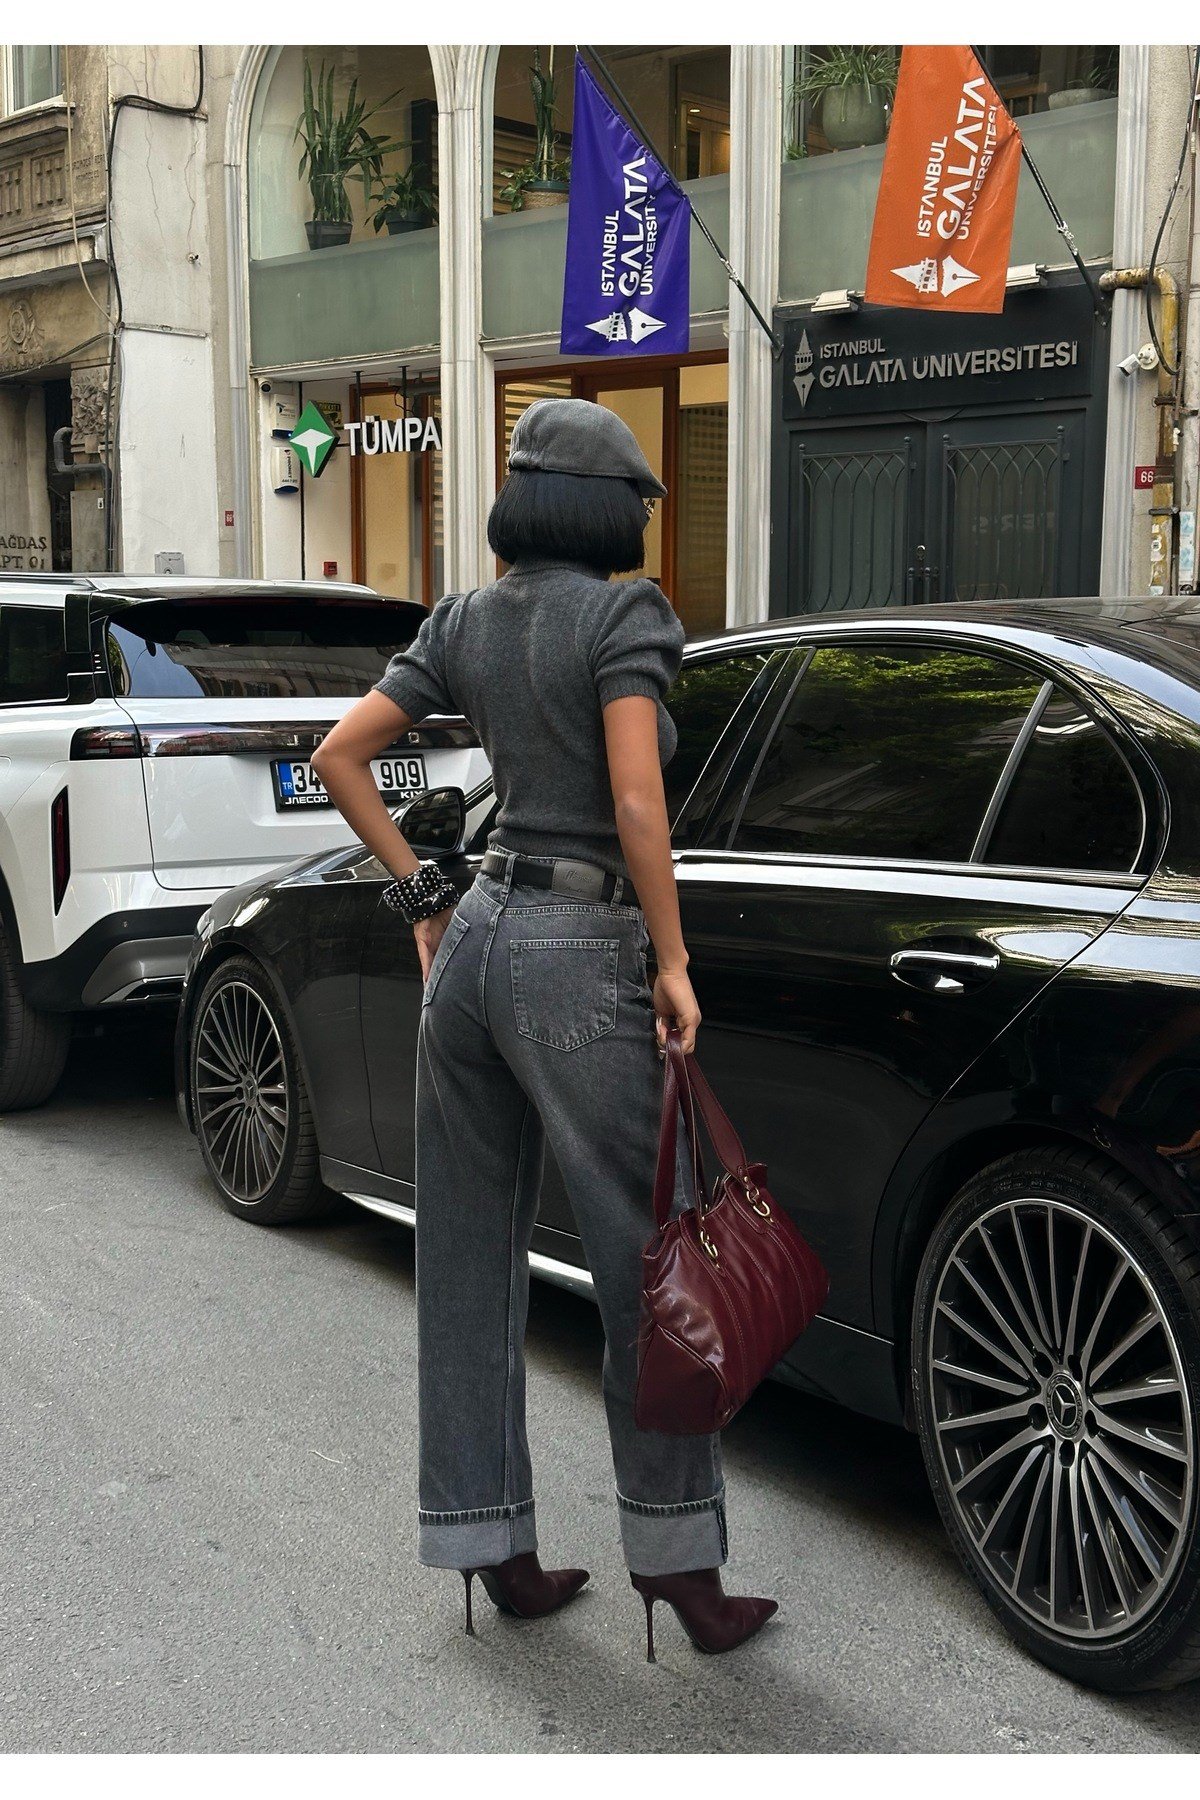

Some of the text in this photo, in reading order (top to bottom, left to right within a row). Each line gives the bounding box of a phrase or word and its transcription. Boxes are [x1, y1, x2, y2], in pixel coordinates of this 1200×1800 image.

[936, 77, 986, 240] GALATA
[618, 157, 648, 297] GALATA
[819, 358, 908, 389] GALATA
[343, 415, 442, 457] TÜMPA
[1140, 470, 1154, 483] 66
[282, 760, 421, 793] TR 34 909
[285, 795, 329, 805] JAECOO
